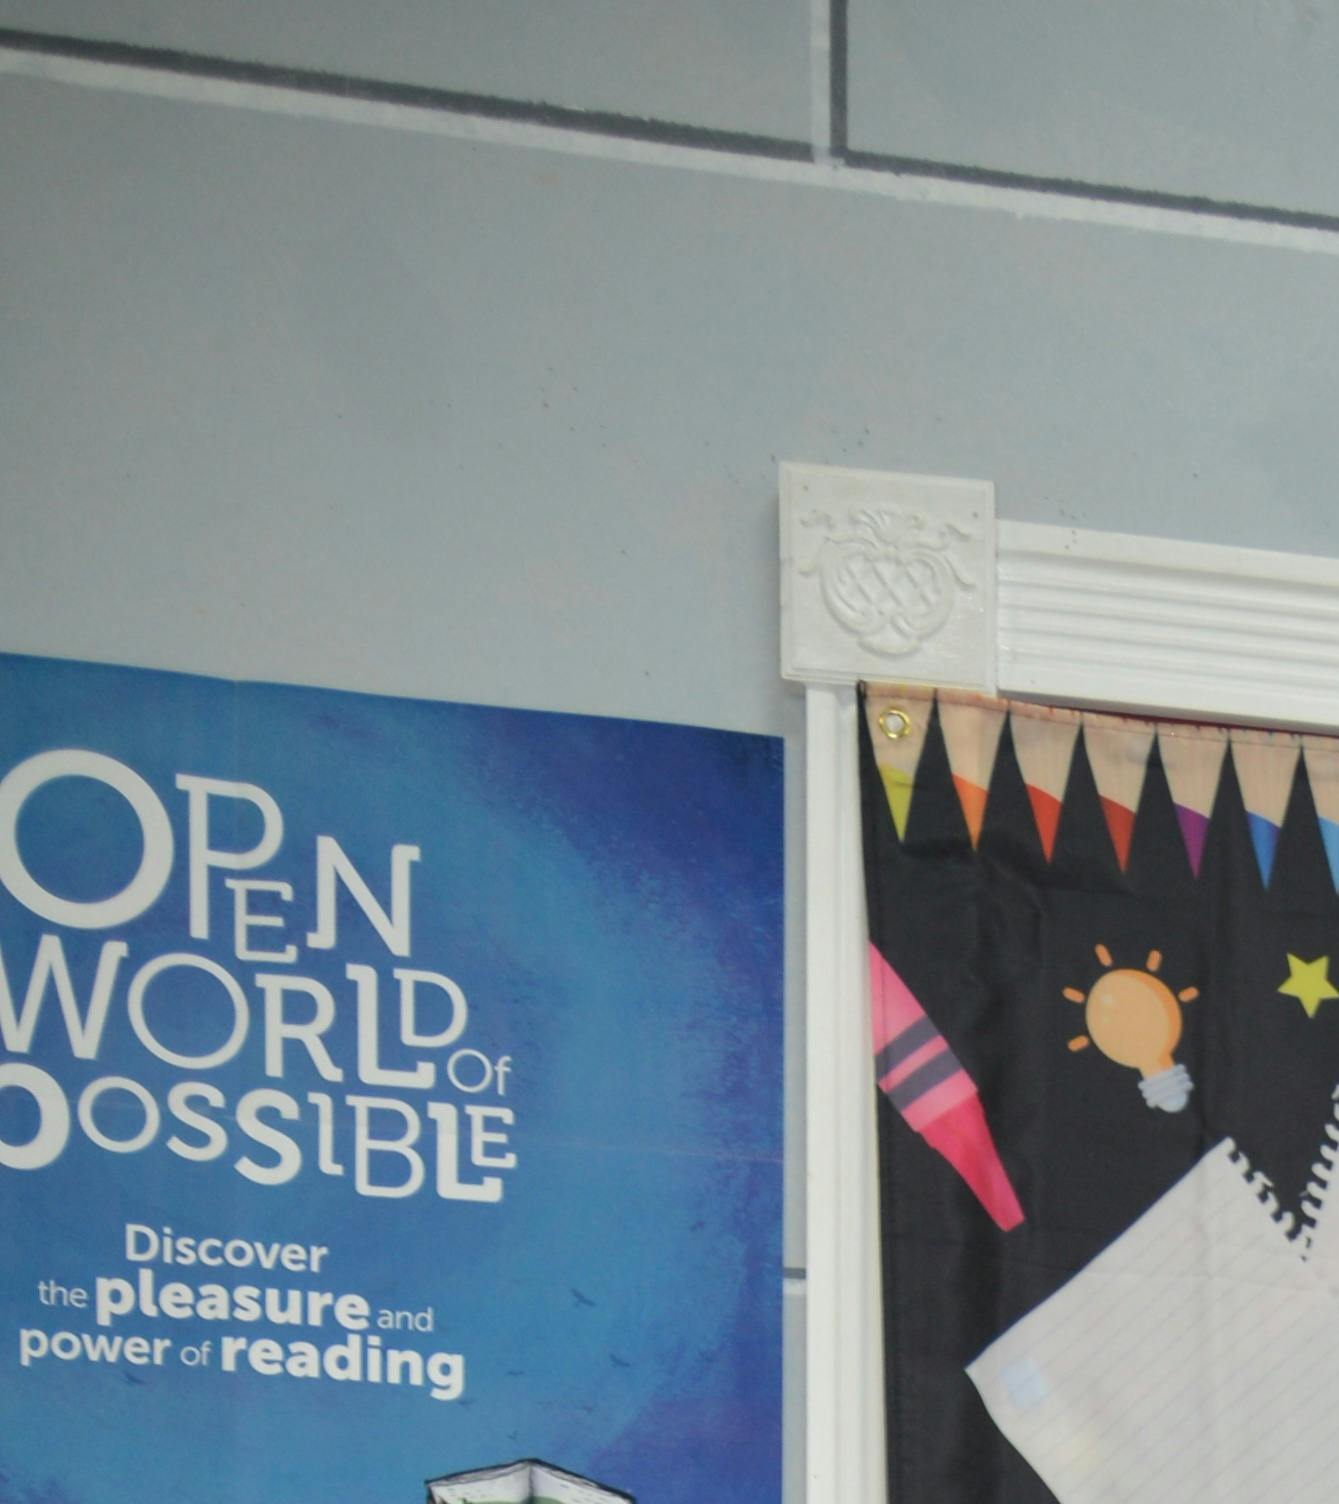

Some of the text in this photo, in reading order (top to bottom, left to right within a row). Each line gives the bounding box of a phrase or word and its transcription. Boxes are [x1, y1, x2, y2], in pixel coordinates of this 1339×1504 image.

[0, 749, 421, 964] OPEN
[0, 933, 468, 1090] WORLD
[125, 1223, 328, 1273] Discover
[38, 1268, 434, 1333] the pleasure and
[19, 1327, 466, 1401] power of reading
